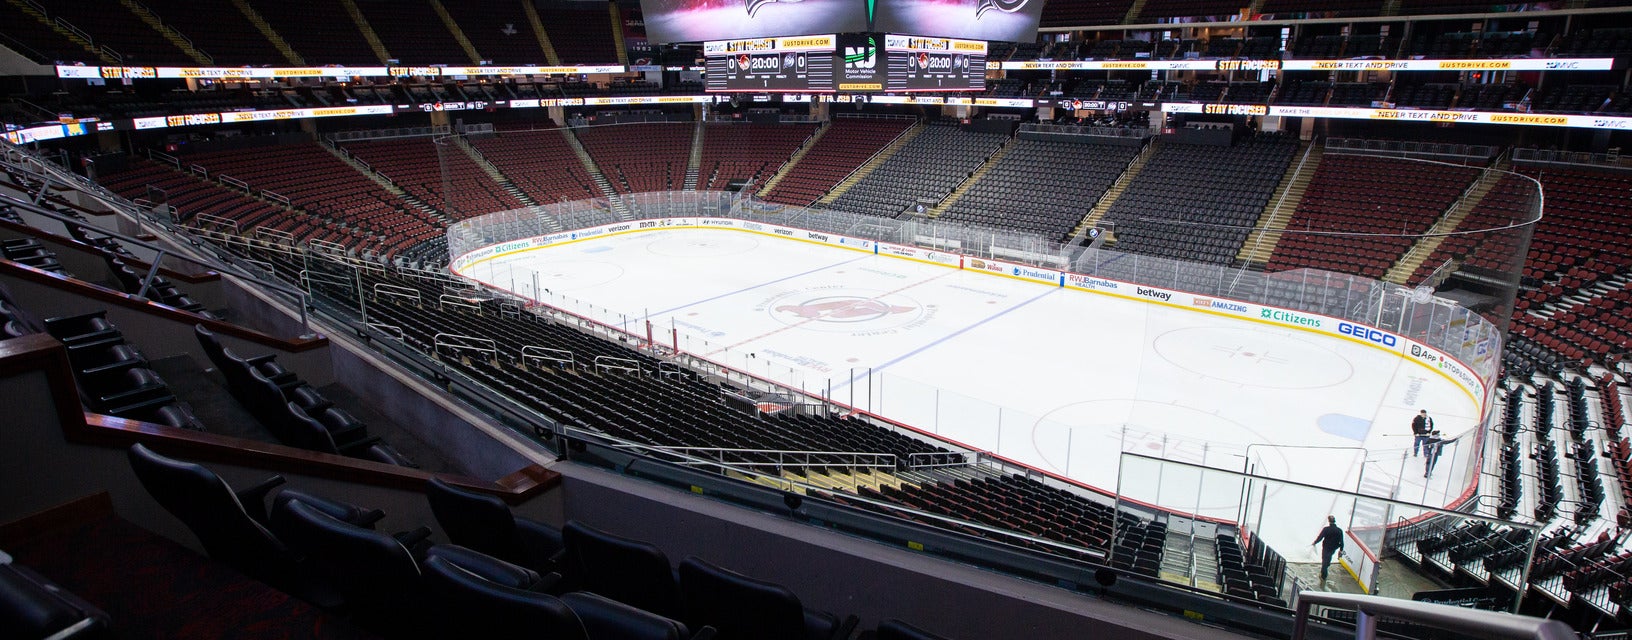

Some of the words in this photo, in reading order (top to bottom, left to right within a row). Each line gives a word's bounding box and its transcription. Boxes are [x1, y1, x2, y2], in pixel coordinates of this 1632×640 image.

[783, 39, 829, 47] JUSTDRIVE.COM
[752, 57, 778, 69] 20:00
[798, 56, 804, 67] 0
[845, 46, 876, 69] NJ
[910, 56, 915, 67] 0
[929, 58, 950, 68] 20:00
[729, 59, 734, 69] 0
[964, 59, 968, 68] 0
[1220, 61, 1239, 70] STAY
[1241, 60, 1279, 70] FOCUSED
[102, 67, 122, 78] STAY
[390, 67, 408, 76] STAY
[1205, 104, 1226, 114] STAY
[1228, 104, 1266, 115] FOCUSED
[167, 115, 185, 127] STAY
[1492, 115, 1565, 124] JUSTDRIVE.COM
[579, 229, 604, 238] Prudential
[608, 225, 630, 233] verizon
[774, 228, 793, 236] verizon
[808, 232, 829, 242] betway
[502, 241, 529, 252] Citizens
[1023, 269, 1055, 281] Prudential
[1069, 274, 1118, 289] RWJBarnabas
[1075, 282, 1096, 290] HEALTH
[1137, 287, 1172, 301] betway
[1211, 300, 1248, 313] AMAZING
[1273, 310, 1321, 327] Citizens
[1338, 322, 1397, 347] GEICO
